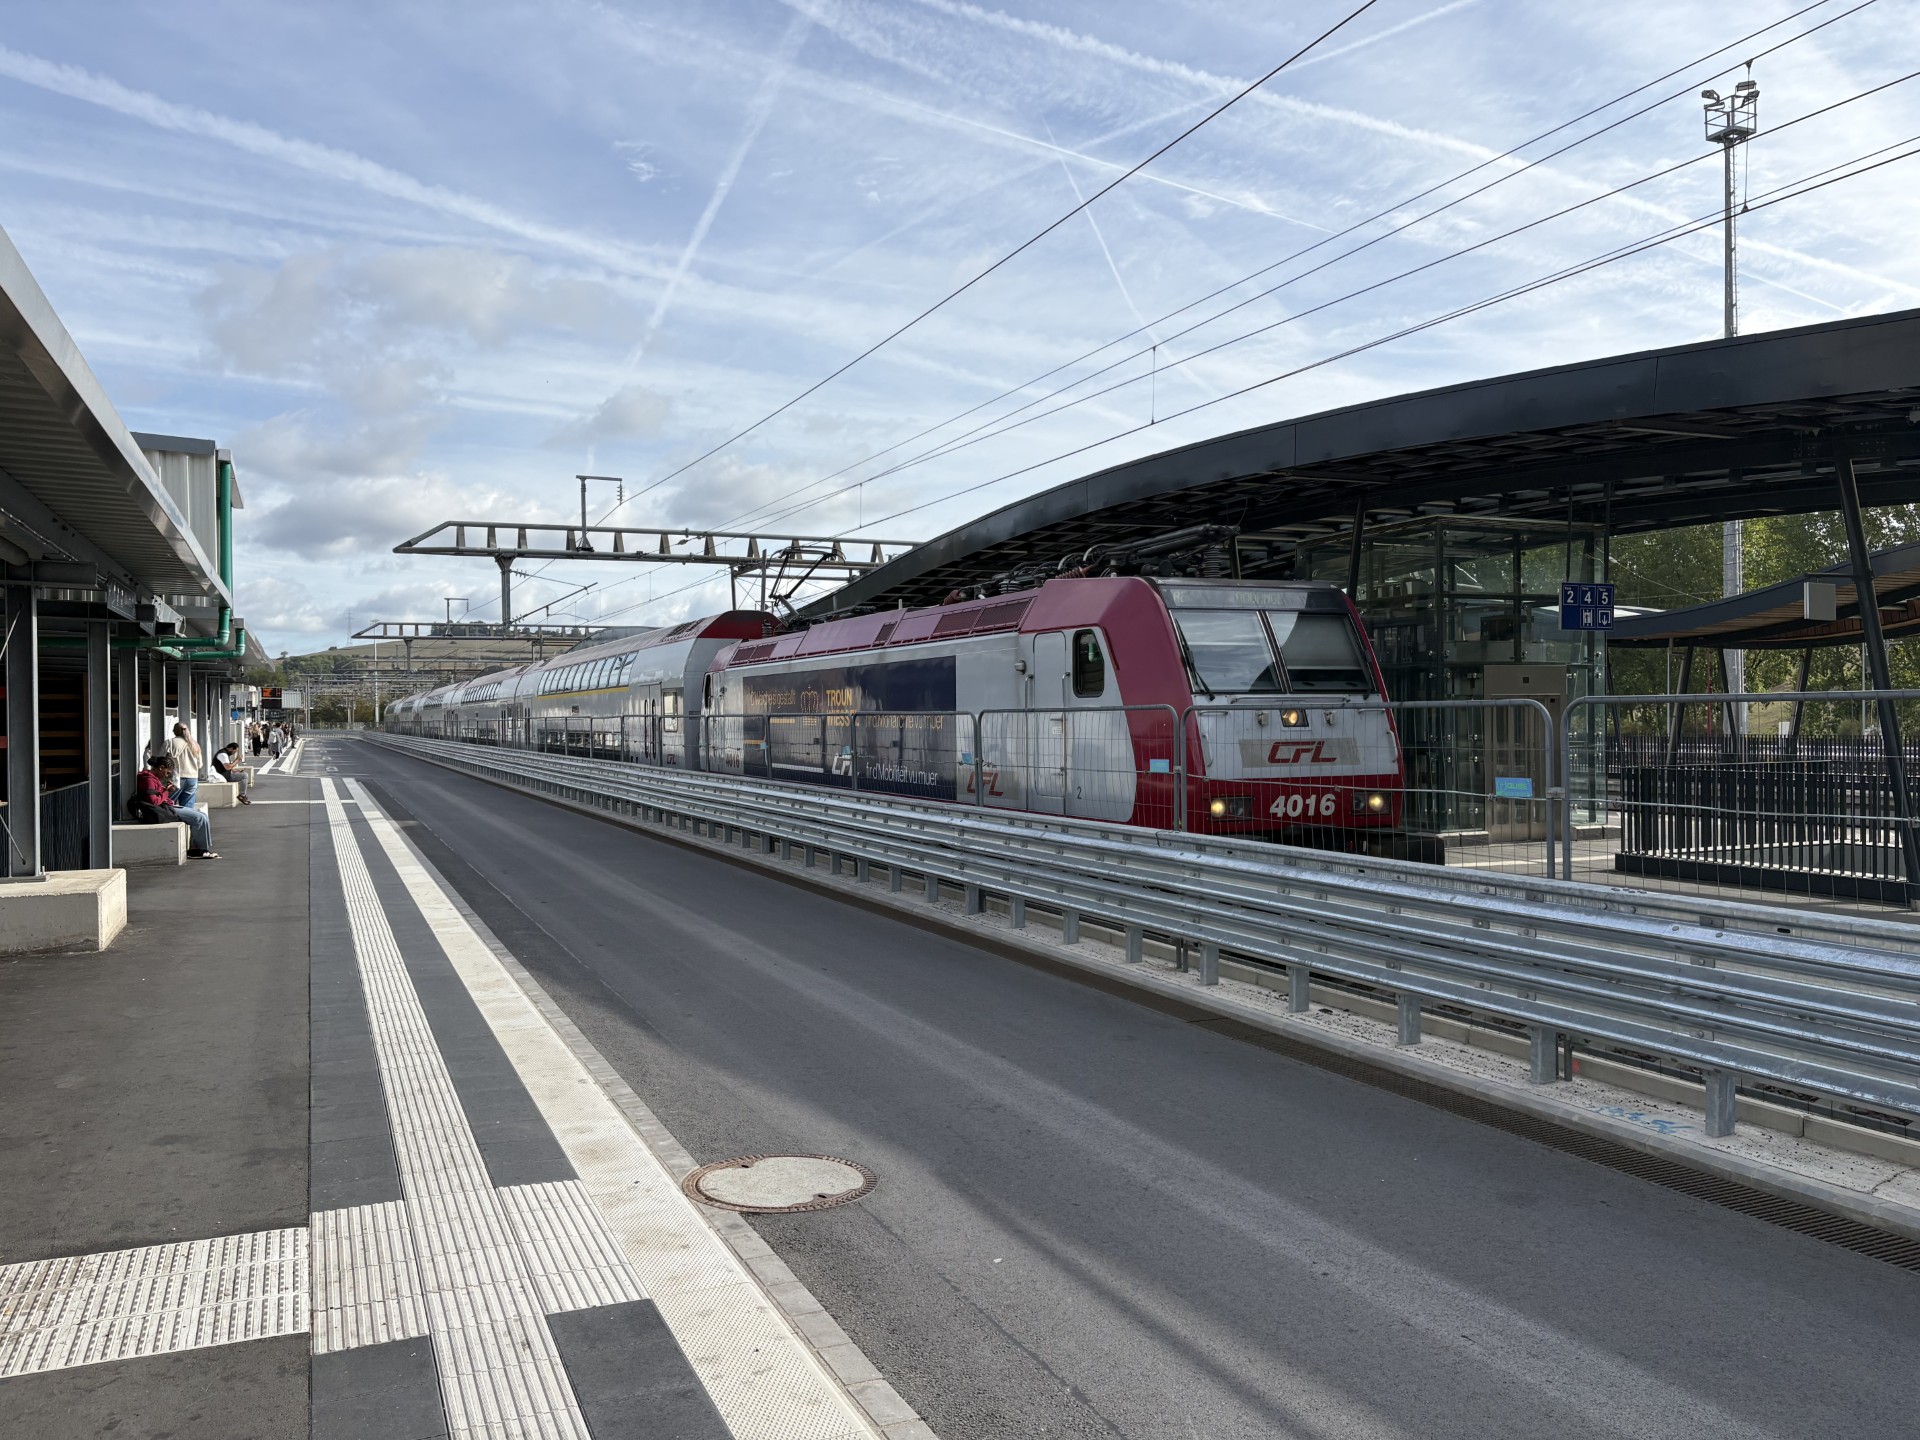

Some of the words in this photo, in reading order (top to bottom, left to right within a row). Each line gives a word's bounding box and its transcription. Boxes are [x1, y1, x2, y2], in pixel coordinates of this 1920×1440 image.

[1567, 591, 1574, 603] 2
[1584, 591, 1592, 604] 4
[1601, 592, 1609, 605] 5
[826, 688, 853, 706] TROUN
[1267, 740, 1338, 764] CFL
[1076, 786, 1082, 800] 2
[1269, 793, 1336, 818] 4016
